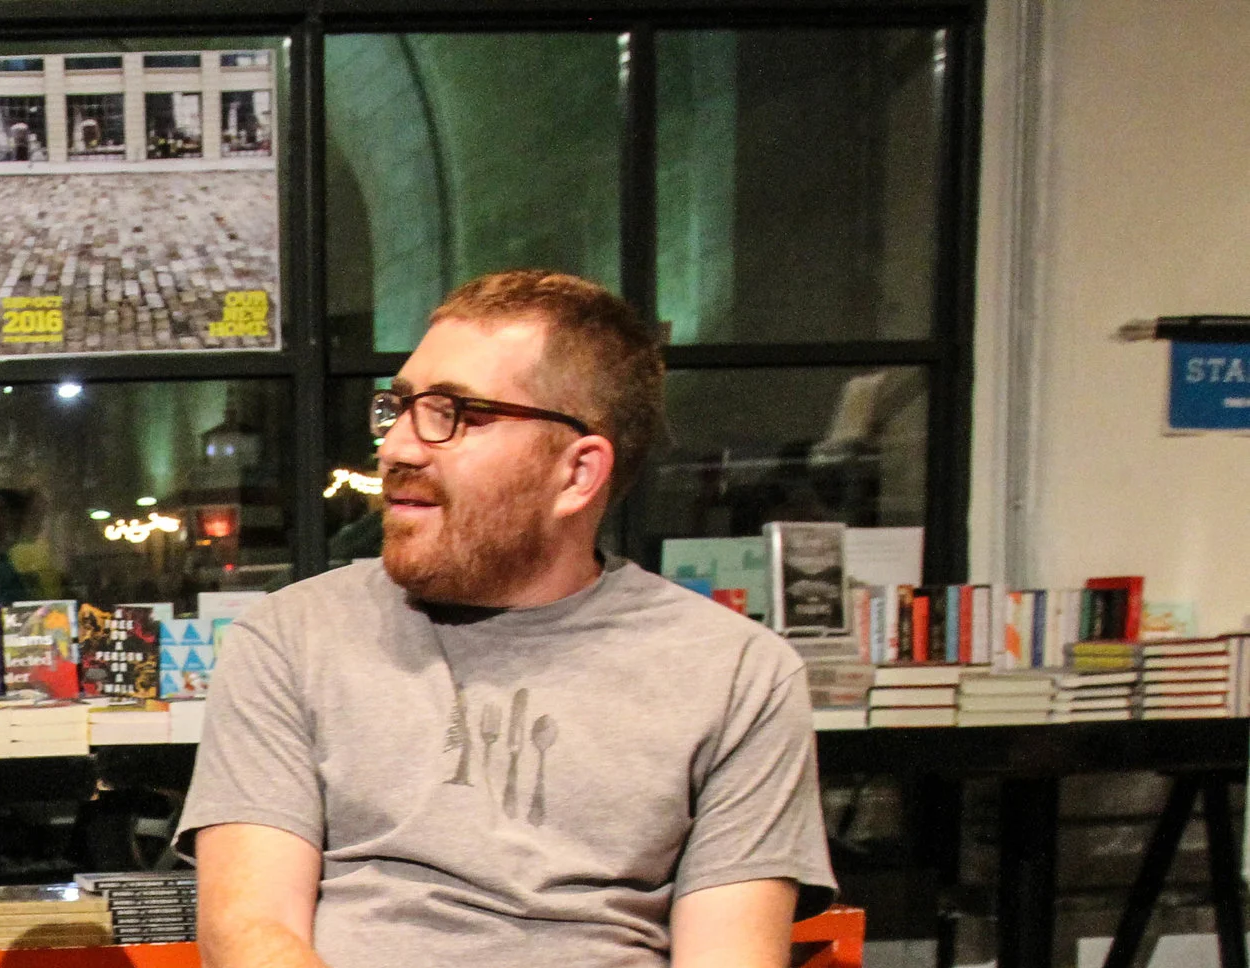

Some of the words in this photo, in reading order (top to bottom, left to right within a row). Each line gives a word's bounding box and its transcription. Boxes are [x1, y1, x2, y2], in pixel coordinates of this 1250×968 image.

[225, 291, 267, 307] OUR
[2, 309, 64, 333] 2016
[209, 321, 269, 338] HOME
[1185, 357, 1250, 384] STA
